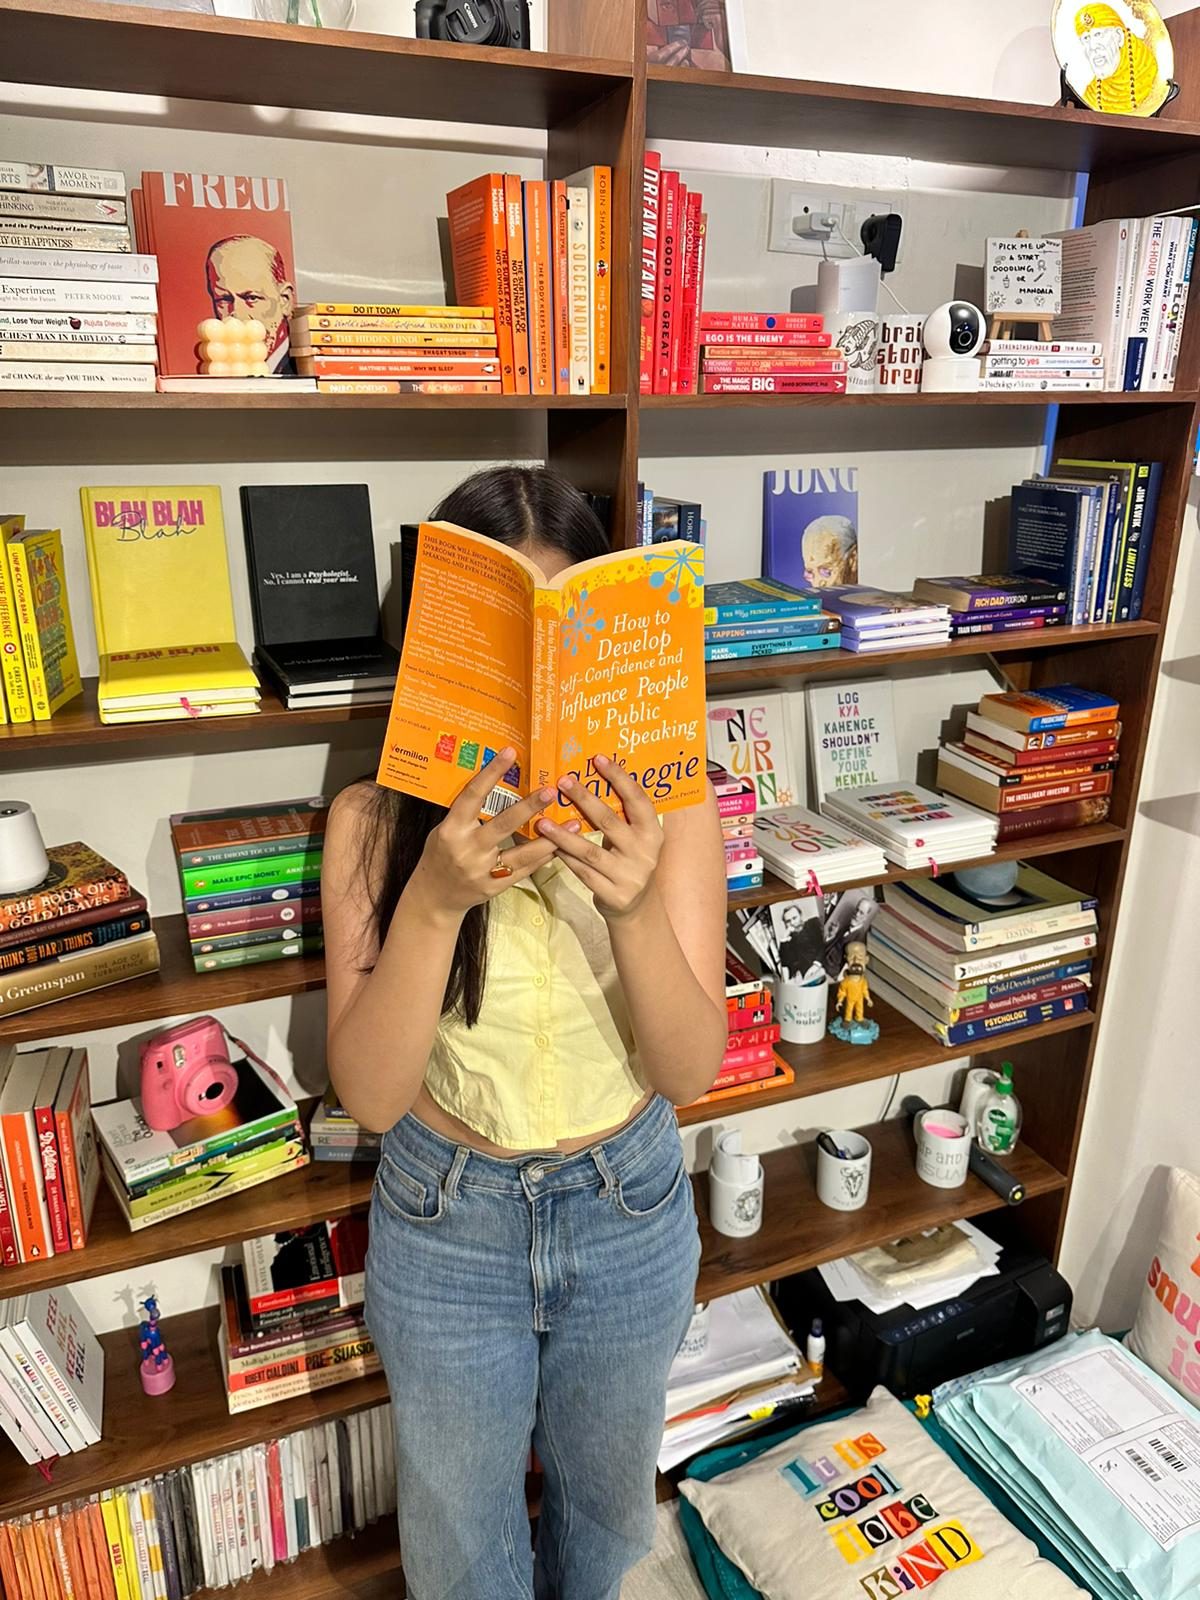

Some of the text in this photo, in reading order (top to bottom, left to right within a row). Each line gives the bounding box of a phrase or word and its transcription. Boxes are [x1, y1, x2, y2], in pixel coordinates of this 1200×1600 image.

[58, 171, 88, 180] SAVOR
[60, 180, 103, 190] MOMENT
[162, 171, 290, 212] FREU
[23, 237, 73, 248] HAPPINESS
[1167, 241, 1175, 260] WHAT
[664, 236, 673, 276] GOOD
[1139, 221, 1162, 333] THE 4-HOUR WORK WEEK
[2, 285, 55, 296] Experiment
[663, 283, 672, 303] TO
[353, 306, 365, 314] DO
[573, 243, 587, 362] SOCCERNOMICS
[46, 319, 68, 327] Weight
[882, 322, 921, 343] brai
[36, 333, 57, 341] MAN
[336, 335, 391, 343] THE HIDDEN
[661, 311, 671, 358] GREAT
[705, 334, 724, 342] EGO
[877, 344, 920, 364] stor
[991, 357, 1018, 366] getting
[1027, 358, 1039, 366] yes
[752, 377, 775, 391] BIG
[94, 500, 205, 528] BLAH BLAH
[1131, 486, 1147, 528] JIM KWIK
[112, 511, 197, 542] Blah
[424, 535, 470, 555] THIS BOOK WILL
[423, 542, 495, 573] OVERCOME THE NATURAL
[423, 550, 480, 574] SPEAKING AND EVEN
[308, 570, 350, 578] Psychologist.
[1123, 548, 1138, 589] LIMITLESS
[974, 596, 1005, 608] RICH DAD
[0, 594, 13, 638] DIFFERENCE
[613, 609, 671, 635] How to
[712, 630, 745, 638] TAPPING
[597, 629, 672, 661] Develop
[752, 642, 786, 650] EVERYTHING
[560, 648, 683, 697] Self-Confidence and
[560, 686, 627, 722] Influence
[637, 669, 689, 700] People
[837, 692, 859, 705] LOG
[587, 703, 660, 735] by Public
[839, 704, 860, 718] KYA
[727, 706, 768, 743] NE
[824, 718, 875, 735] KAHENGE
[617, 720, 699, 754] Speaking
[822, 732, 880, 749] SHOULDN'T
[390, 743, 429, 763] Vermilion
[731, 739, 774, 775] UR
[831, 746, 872, 761] DEFINE
[585, 753, 626, 778] De
[838, 759, 868, 774] YOUR
[835, 772, 878, 787] MENTAL
[1006, 786, 1070, 803] THE INTELLIGENT INVESTOR
[224, 851, 248, 859] DHONI
[250, 847, 275, 856] TOUCH
[212, 870, 280, 885] MAKE EPIC MONEY
[5, 881, 107, 917] THE BOOK OF
[9, 894, 111, 929] GOLD LEAVES
[63, 931, 94, 951] THINGS
[94, 960, 144, 978] TURBULENCE
[968, 959, 1003, 975] Psychology
[6, 971, 85, 1000] Greenspan
[989, 971, 1055, 995] Child Development
[984, 1010, 1027, 1027] PSYCHOLOGY
[143, 1204, 180, 1223] Coaching
[190, 1185, 240, 1206] Breakthrough
[258, 1294, 290, 1309] Emotional
[1148, 1256, 1200, 1336] snu
[46, 1294, 58, 1336] FEEL
[66, 1314, 77, 1380] KEEP IT
[75, 1342, 86, 1384] REAL
[245, 1341, 374, 1385] ROBERT CIALDINI PRE-SUASIO
[35, 1350, 48, 1365] FEEL
[54, 1377, 66, 1393] KEEP
[66, 1398, 79, 1414] REAL
[840, 1433, 886, 1465] is
[781, 1459, 836, 1495] It
[819, 1464, 902, 1519] cool
